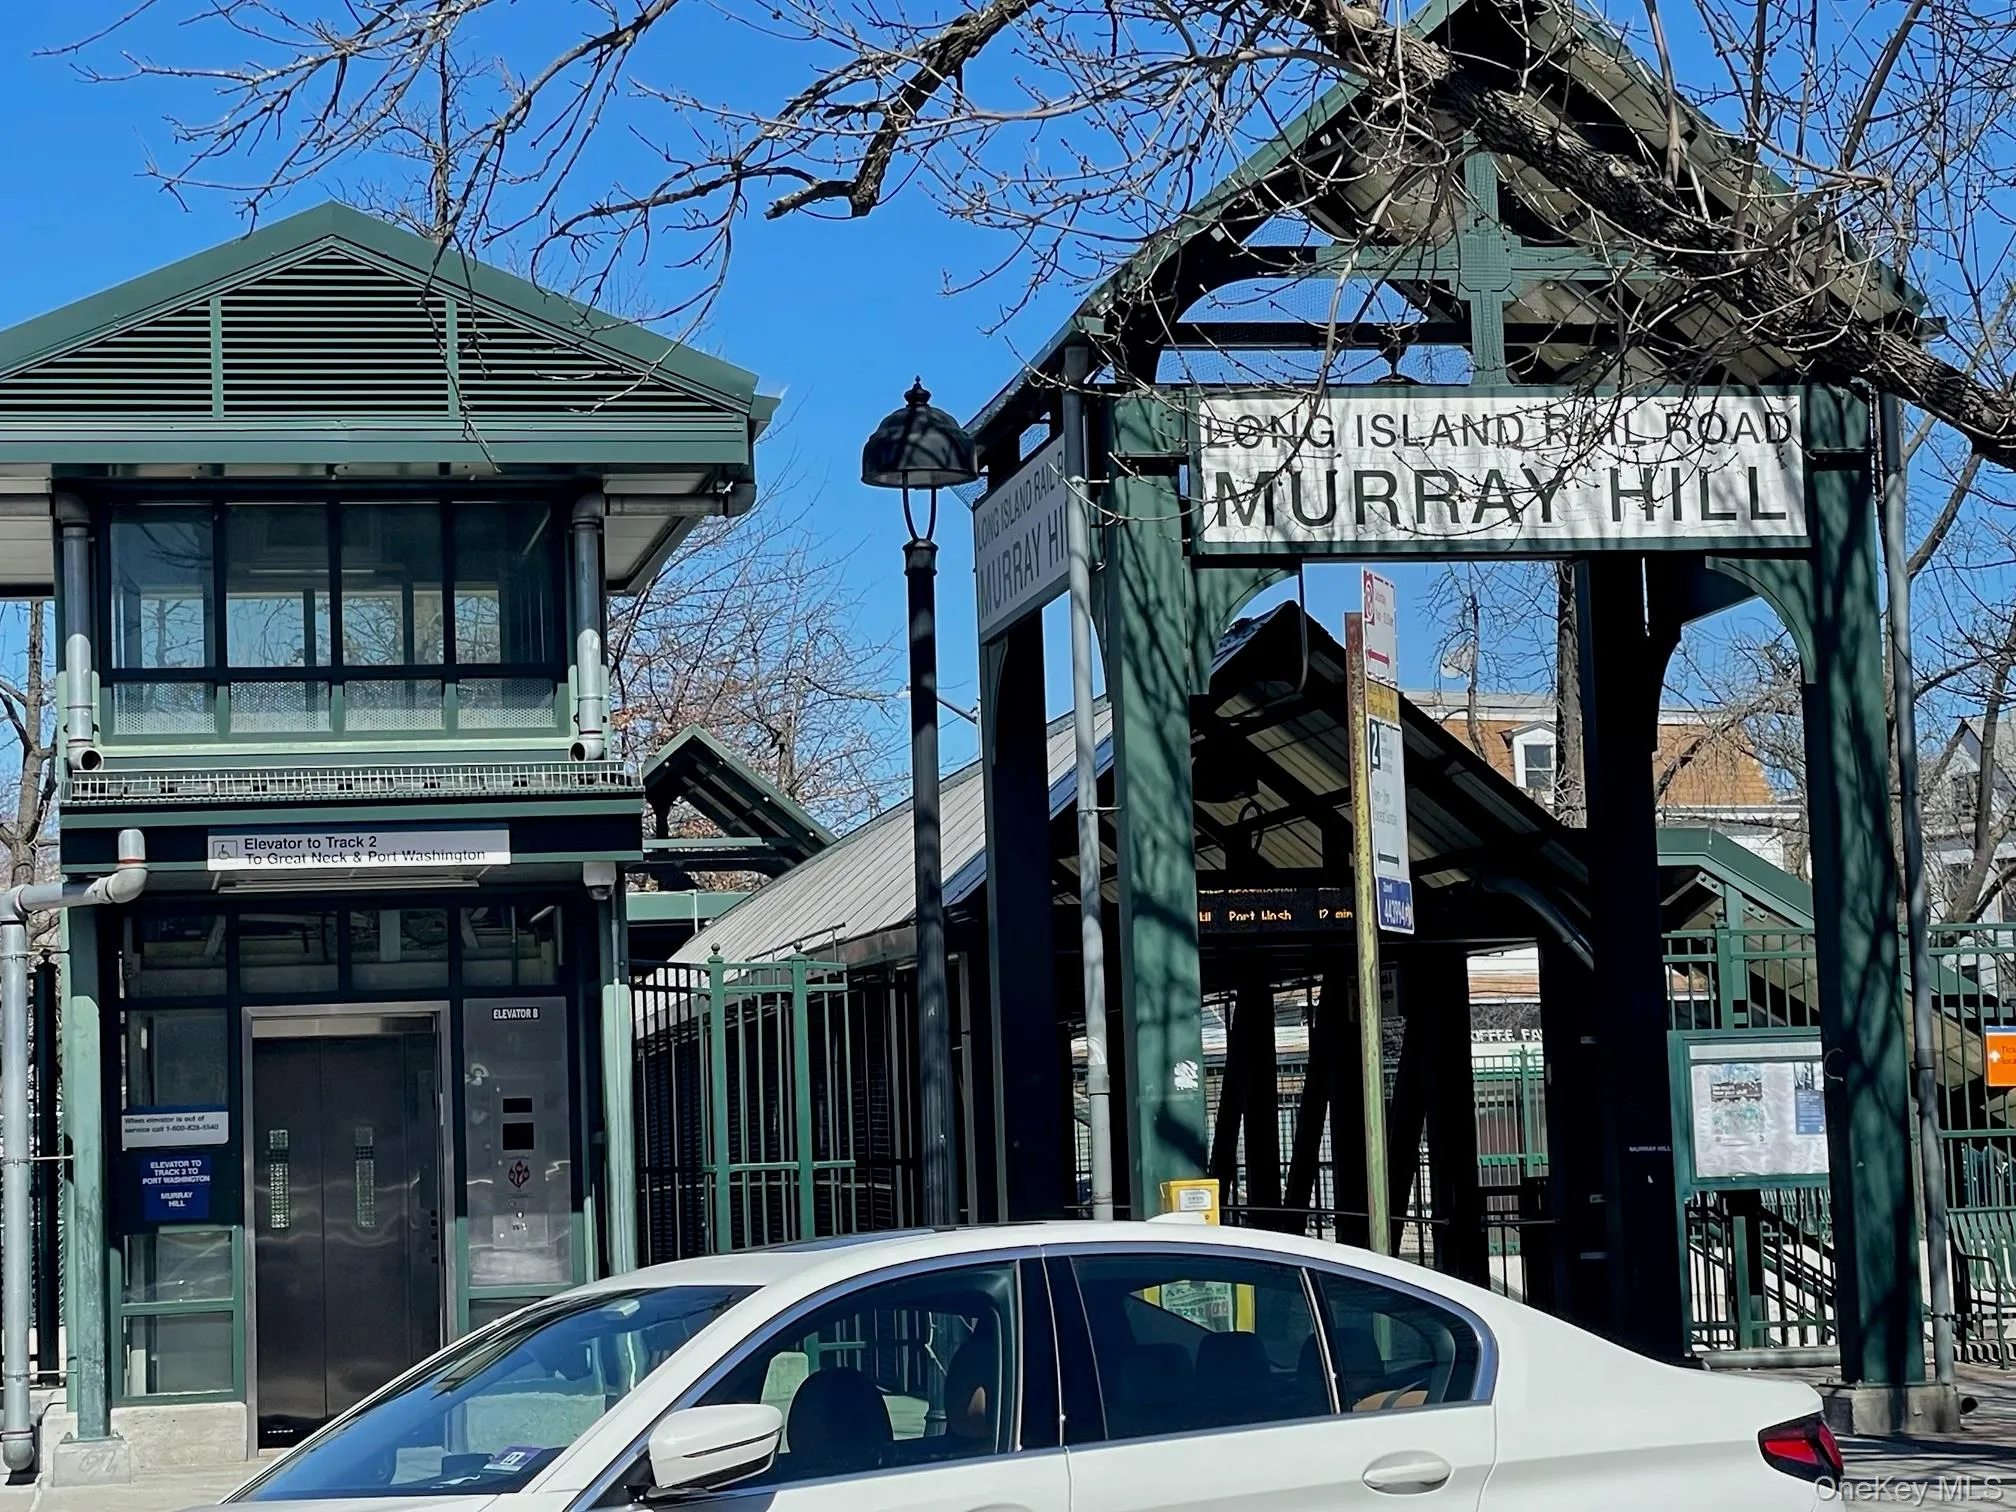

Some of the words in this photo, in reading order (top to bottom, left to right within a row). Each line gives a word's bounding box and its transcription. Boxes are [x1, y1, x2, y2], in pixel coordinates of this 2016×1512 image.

[1205, 413, 1336, 449] LONG
[1356, 413, 1524, 447] ISLAND
[1545, 412, 1647, 446] RAIL
[1665, 411, 1793, 445] ROAD
[1215, 468, 1568, 527] MURRAY
[1609, 466, 1787, 523] HILL
[976, 509, 1000, 552] LONG
[1001, 482, 1032, 531] ISLAND
[1033, 461, 1055, 506] RAIL
[979, 522, 1041, 619] MURRAY
[244, 837, 303, 850] Elevator
[307, 838, 321, 849] to
[325, 836, 365, 849] Track
[368, 835, 378, 848] 2
[246, 853, 261, 866] To
[267, 853, 306, 865] Great
[311, 852, 348, 864] Neck
[352, 852, 362, 863] &
[368, 851, 398, 863] Port
[401, 849, 486, 864] Washington
[493, 1008, 531, 1020] ELEVATOR
[532, 1007, 539, 1019] B
[150, 1160, 190, 1169] ELEVATOR
[191, 1159, 202, 1167] TO
[154, 1168, 180, 1176] TRACK
[142, 1177, 161, 1185] PORT
[163, 1175, 211, 1184] WASHINGTON
[160, 1191, 193, 1200] MURRAY
[168, 1200, 186, 1208] HILL
